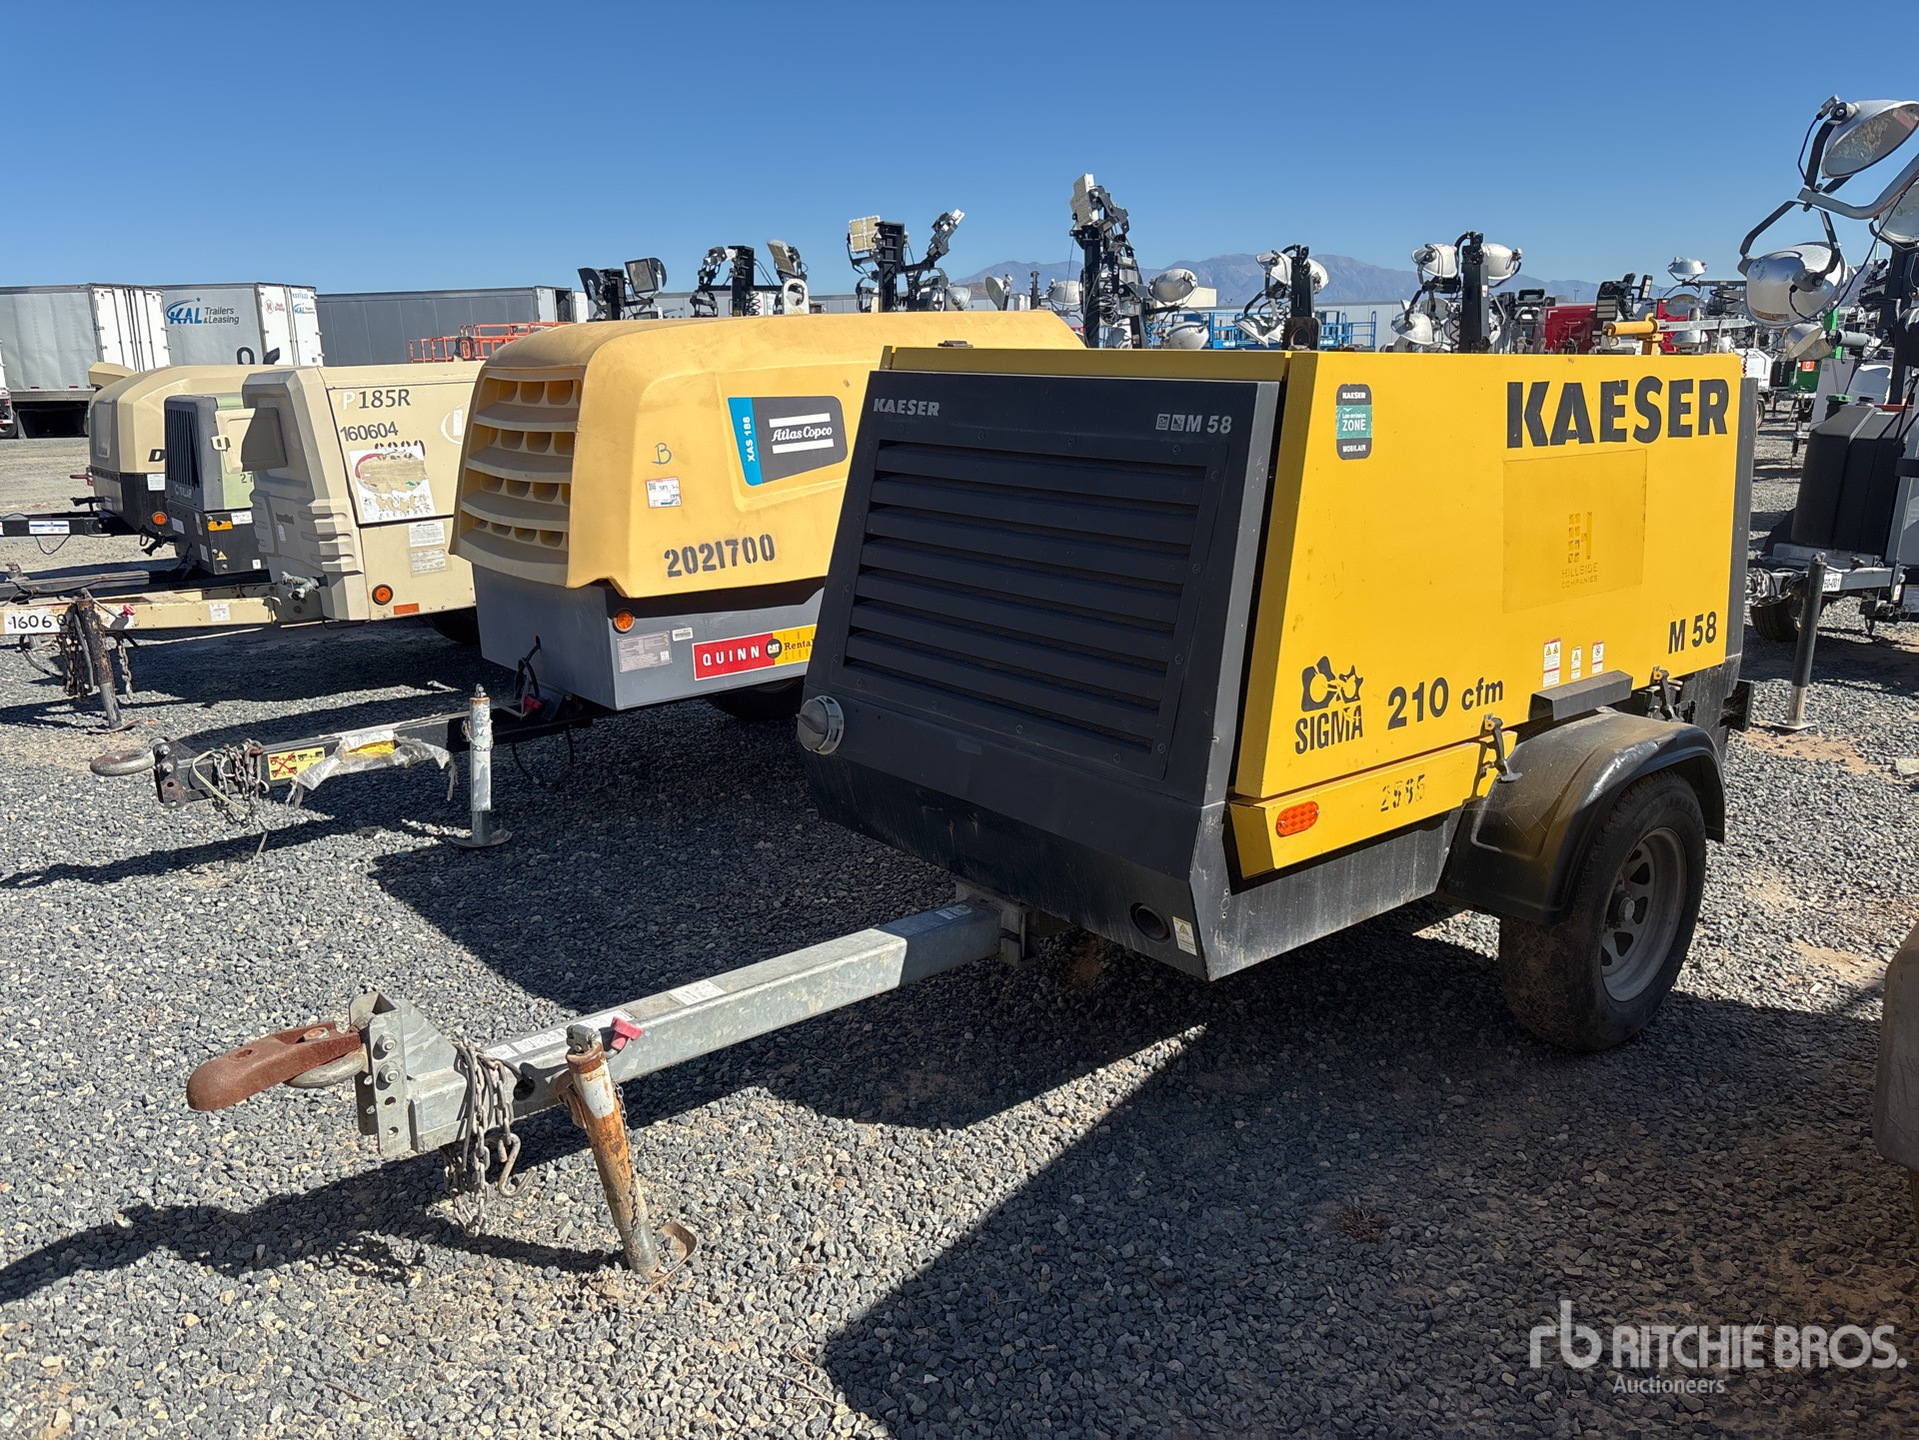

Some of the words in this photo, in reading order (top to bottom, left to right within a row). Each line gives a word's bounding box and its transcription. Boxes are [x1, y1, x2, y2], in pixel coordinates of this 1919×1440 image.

[169, 307, 203, 325] KAL
[204, 306, 235, 315] Trailers
[1342, 391, 1366, 399] KAESER
[873, 398, 940, 417] KAESER
[1507, 375, 1730, 449] KAESER
[340, 421, 399, 442] 160604
[742, 416, 754, 437] 188
[771, 428, 803, 442] Atlas
[803, 425, 833, 440] Copco
[1185, 414, 1203, 432] M
[1206, 415, 1232, 434] 58
[1342, 420, 1366, 431] ZONE
[651, 442, 672, 465] B
[746, 439, 756, 462] XAS
[663, 534, 775, 577] 2021700
[1561, 562, 1598, 579] HILLSIDE
[1668, 618, 1686, 655] M
[1692, 611, 1717, 648] 58
[702, 645, 759, 667] QUINN
[767, 642, 780, 655] CAT
[1386, 676, 1449, 731] 210
[1460, 676, 1504, 711] cfm
[1294, 704, 1364, 755] SIGMA
